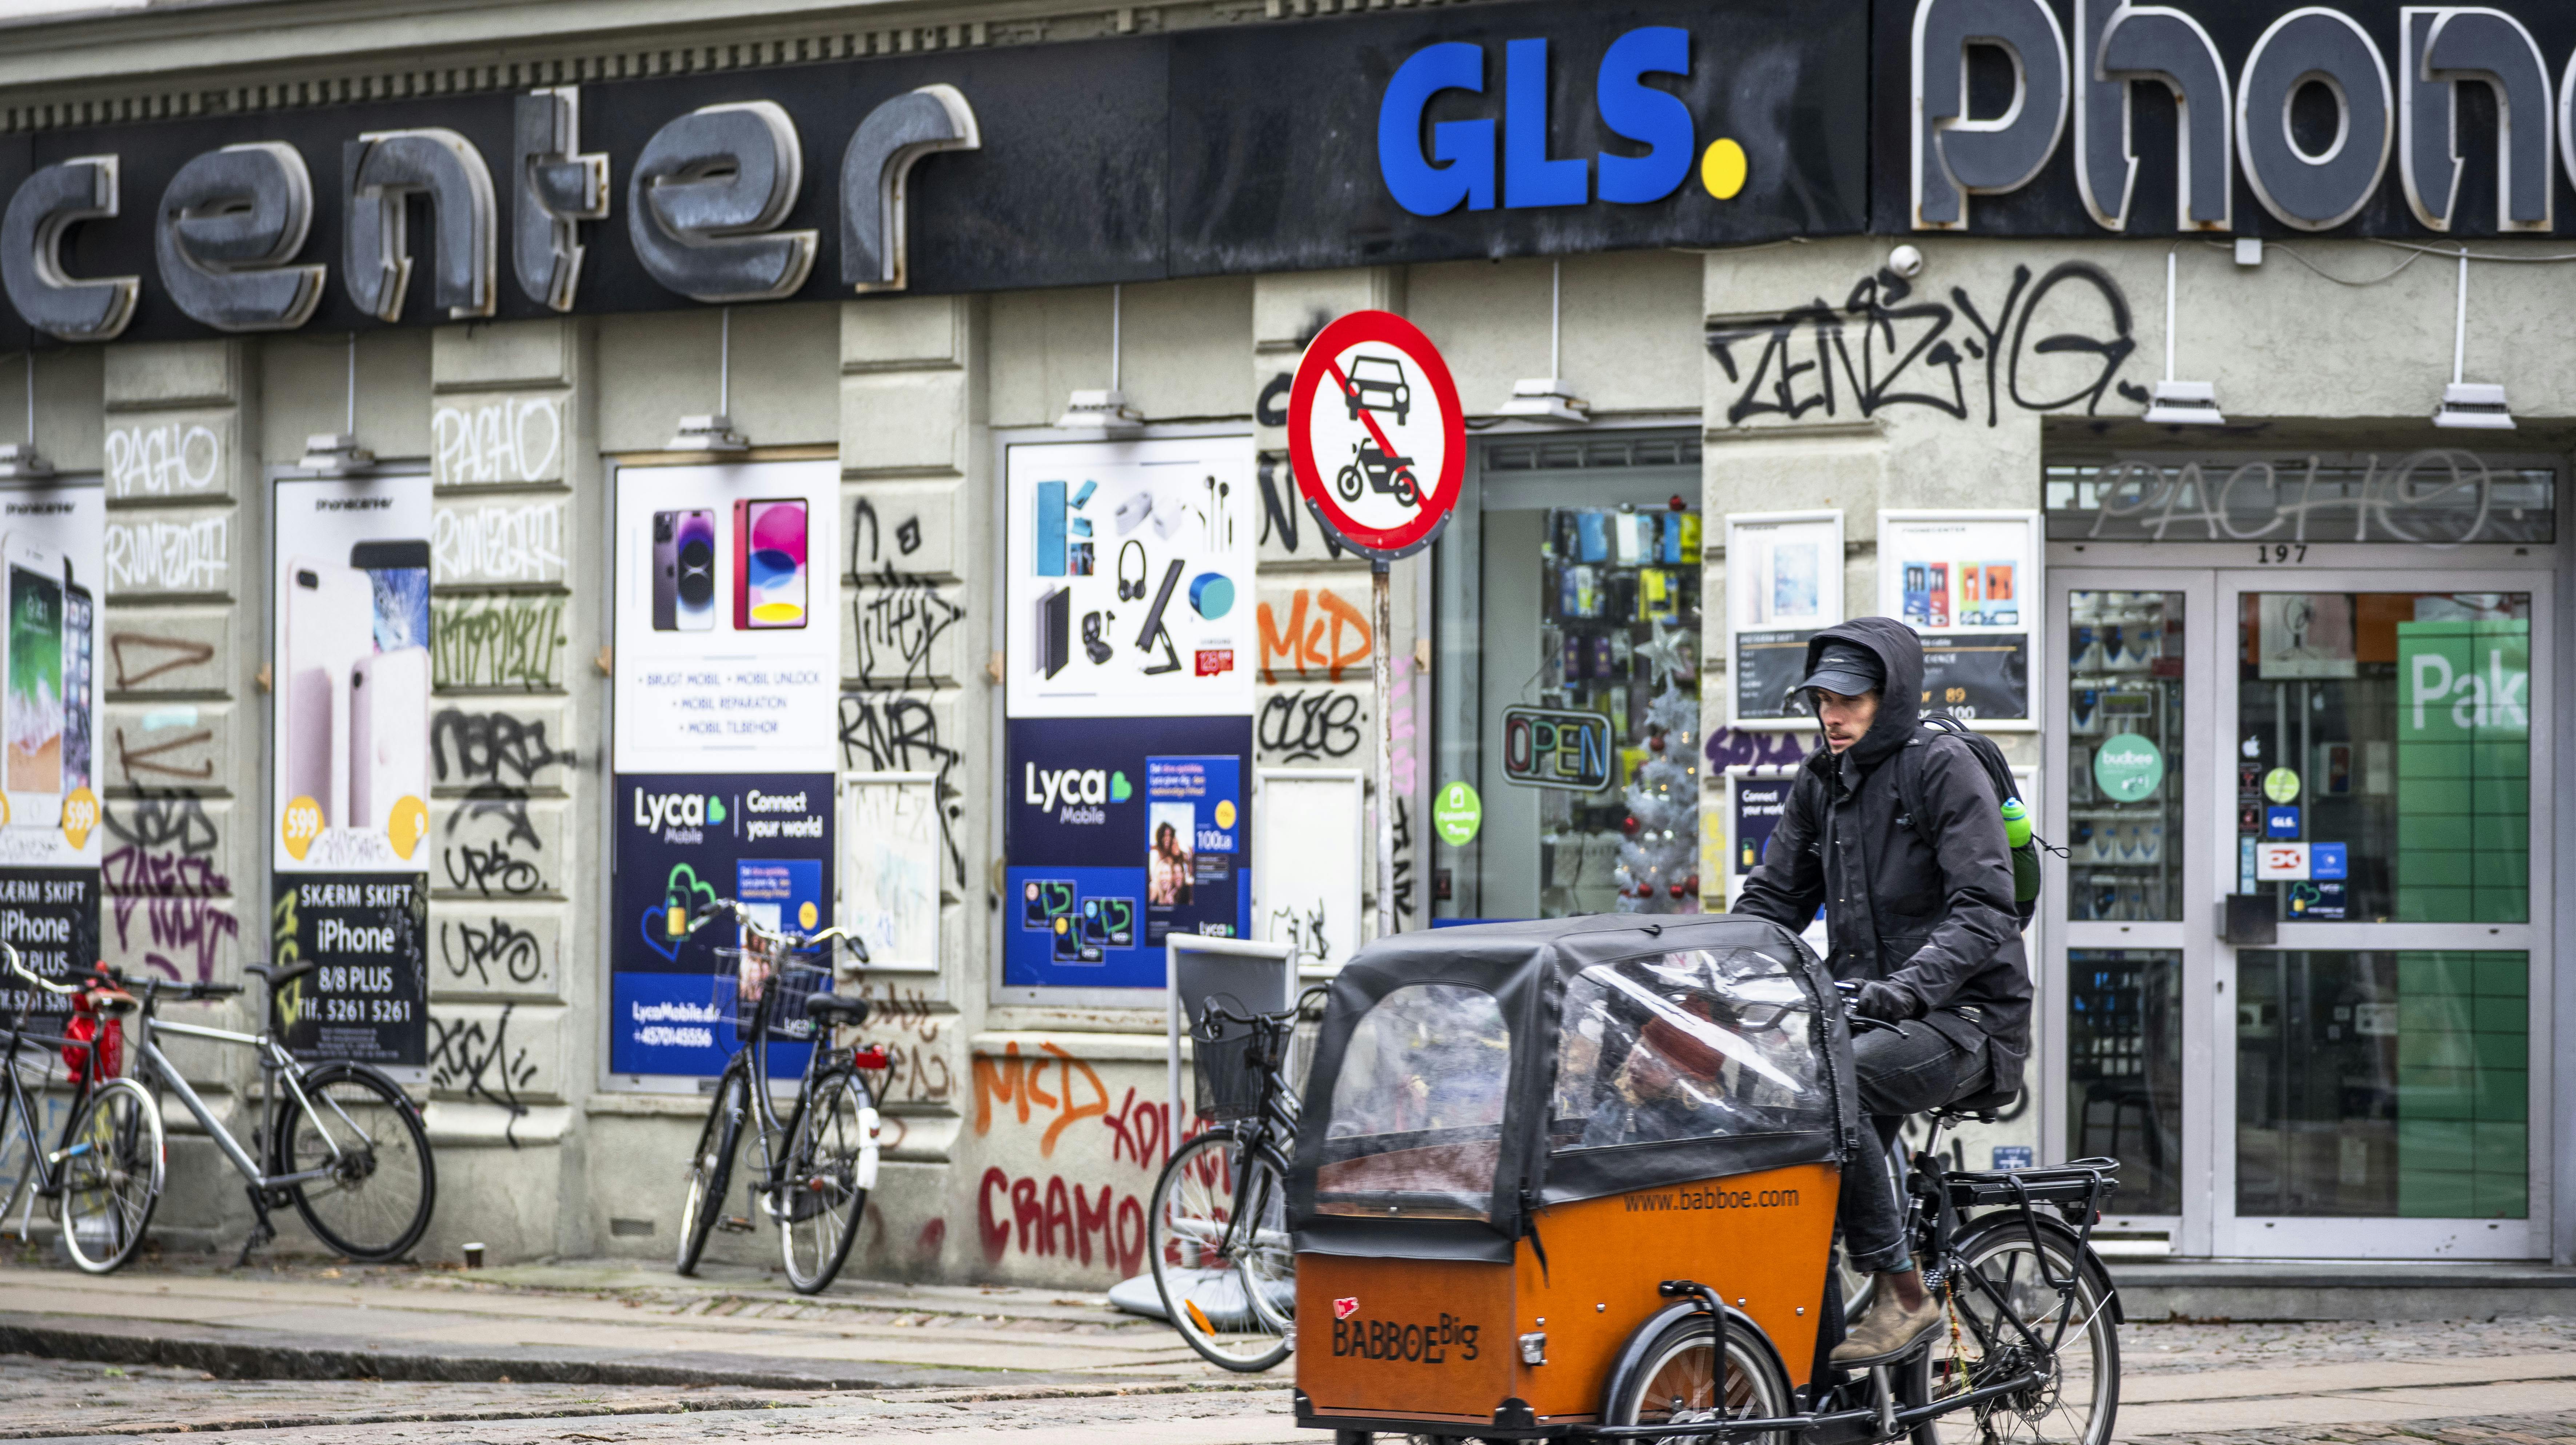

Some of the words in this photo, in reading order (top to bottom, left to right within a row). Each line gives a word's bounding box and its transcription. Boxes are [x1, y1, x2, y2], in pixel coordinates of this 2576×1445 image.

[1378, 25, 1746, 217] GLS.
[0, 84, 981, 342] center
[432, 398, 559, 485] PACHO
[105, 424, 218, 498] PACHO
[2258, 544, 2308, 564] 197
[1945, 687, 1966, 704] 89
[2412, 649, 2528, 729] Pak
[1505, 719, 1607, 777] OPEN
[2102, 749, 2154, 765] budbee
[1026, 762, 1106, 813] Lyca
[1742, 789, 1779, 802] Connect
[635, 788, 705, 833] Lyca
[747, 790, 807, 813] Connect
[1742, 805, 1761, 819] your
[68, 801, 95, 831] 599
[287, 807, 318, 839] 599
[747, 819, 779, 842] your
[782, 816, 823, 837] world
[1060, 807, 1106, 824] Mobile
[665, 828, 703, 844] Mobile
[0, 880, 39, 904] KÆRM
[44, 880, 86, 904] SKIFT
[302, 884, 361, 908] SKÆRM
[366, 884, 412, 908] SKIFT
[1, 909, 71, 943] iPhone
[317, 917, 396, 954] iPhone
[30, 950, 69, 977] PLUS
[318, 966, 347, 993] 8/8
[350, 967, 394, 993] PLUS
[327, 999, 365, 1022] 5261
[372, 999, 411, 1022] 5261
[1623, 1185, 1800, 1213] www.babboe.com
